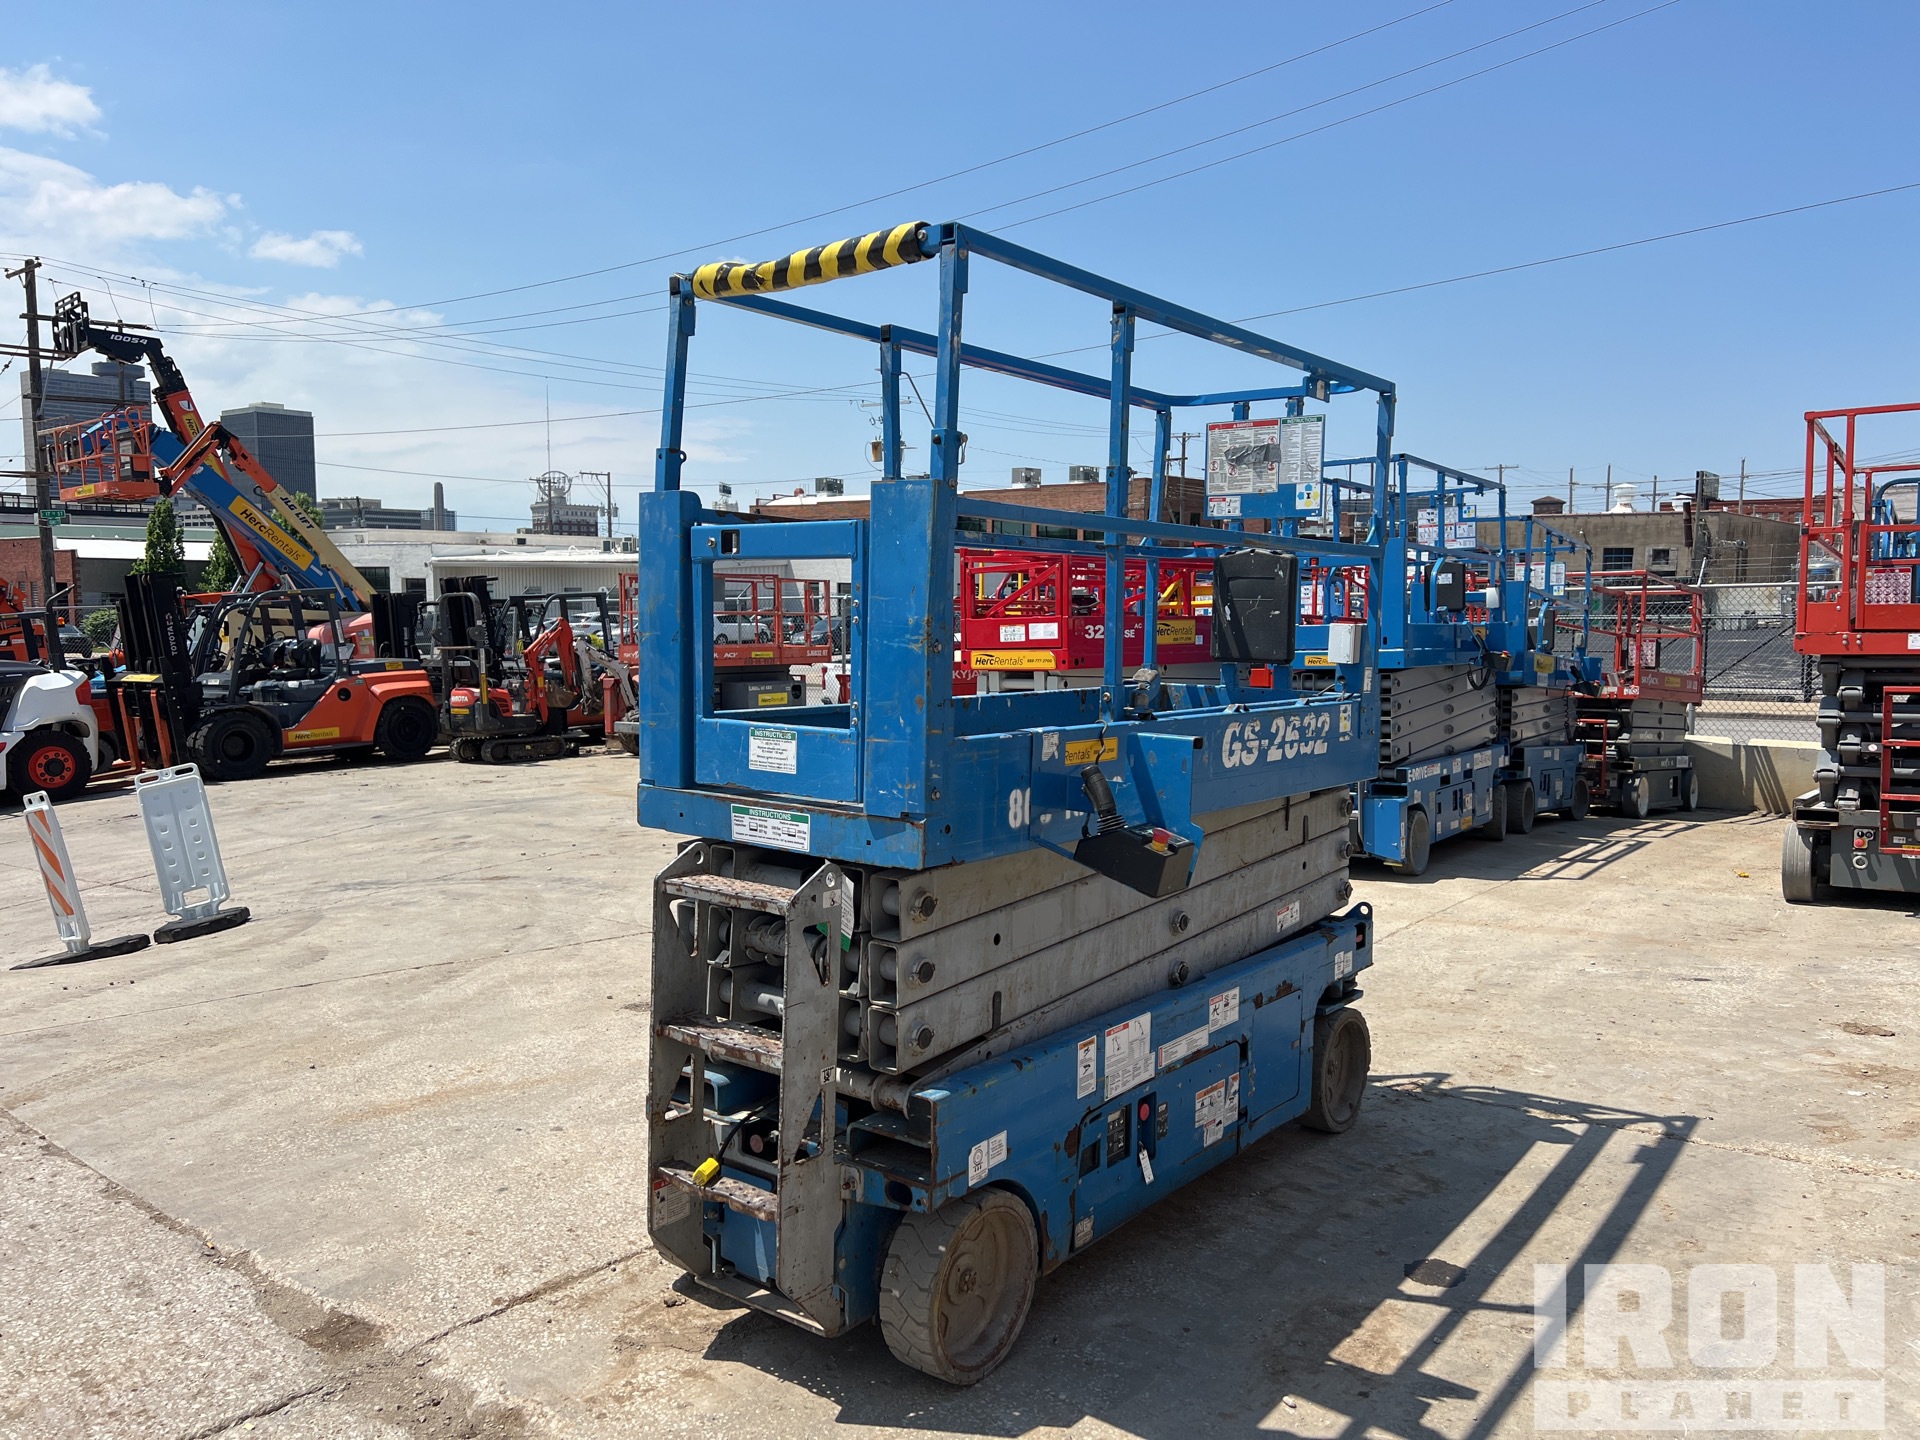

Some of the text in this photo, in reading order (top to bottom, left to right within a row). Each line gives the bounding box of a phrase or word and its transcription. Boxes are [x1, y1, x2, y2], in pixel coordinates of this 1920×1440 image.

[110, 333, 148, 345] 10054
[280, 496, 315, 530] JLG LIFT
[240, 508, 303, 561] HercRentals
[168, 620, 178, 656] TOYOTA
[975, 656, 1024, 666] HercRentals
[294, 730, 334, 740] HercRentals
[748, 808, 792, 821] INSTRUCTIONS
